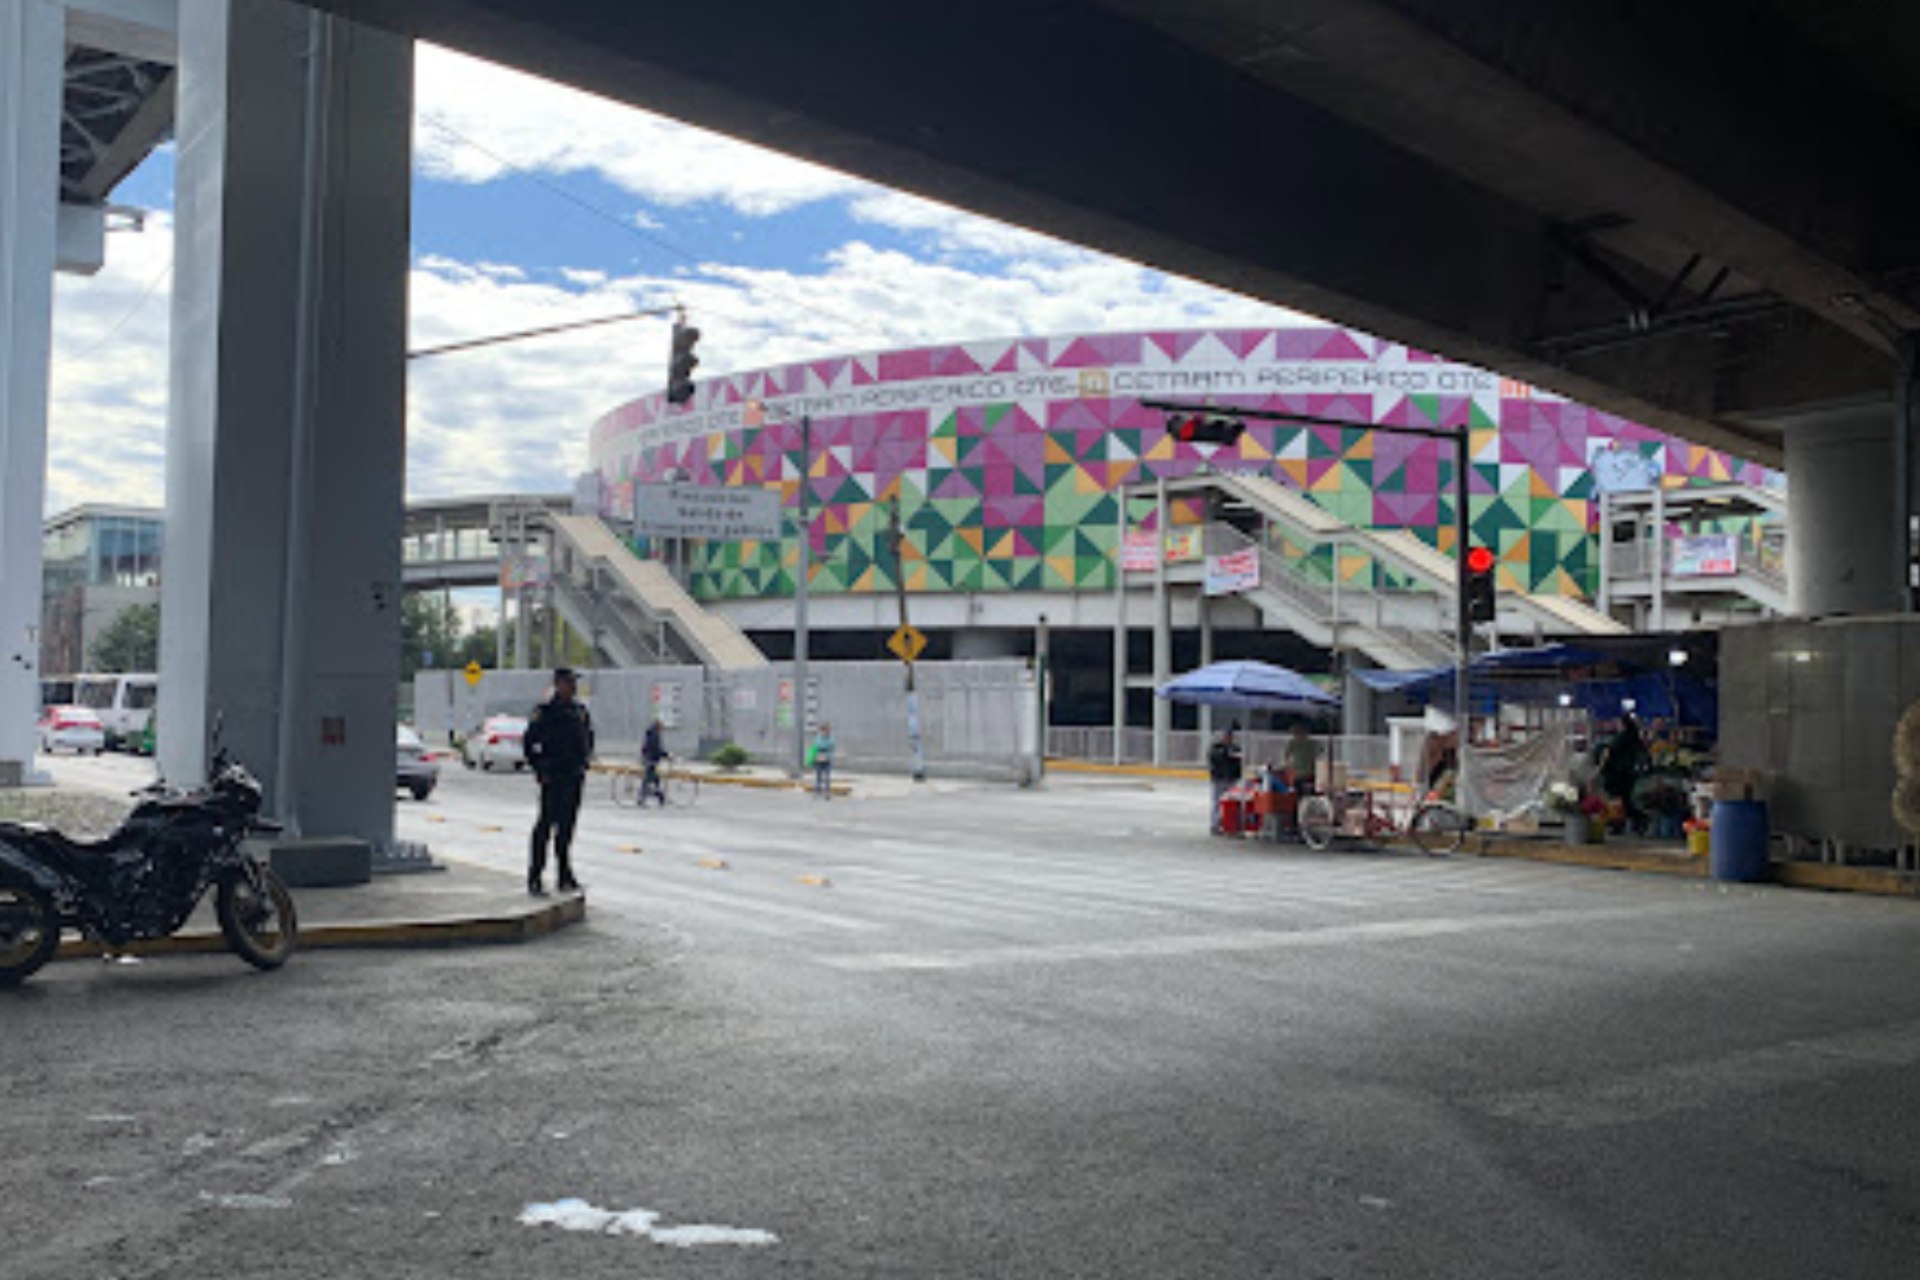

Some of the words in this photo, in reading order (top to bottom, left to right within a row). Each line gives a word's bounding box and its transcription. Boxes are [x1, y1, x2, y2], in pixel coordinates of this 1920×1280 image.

[1114, 371, 1246, 390] CETRAM
[1257, 368, 1429, 390] PERIFERICO
[1438, 371, 1491, 390] OTE
